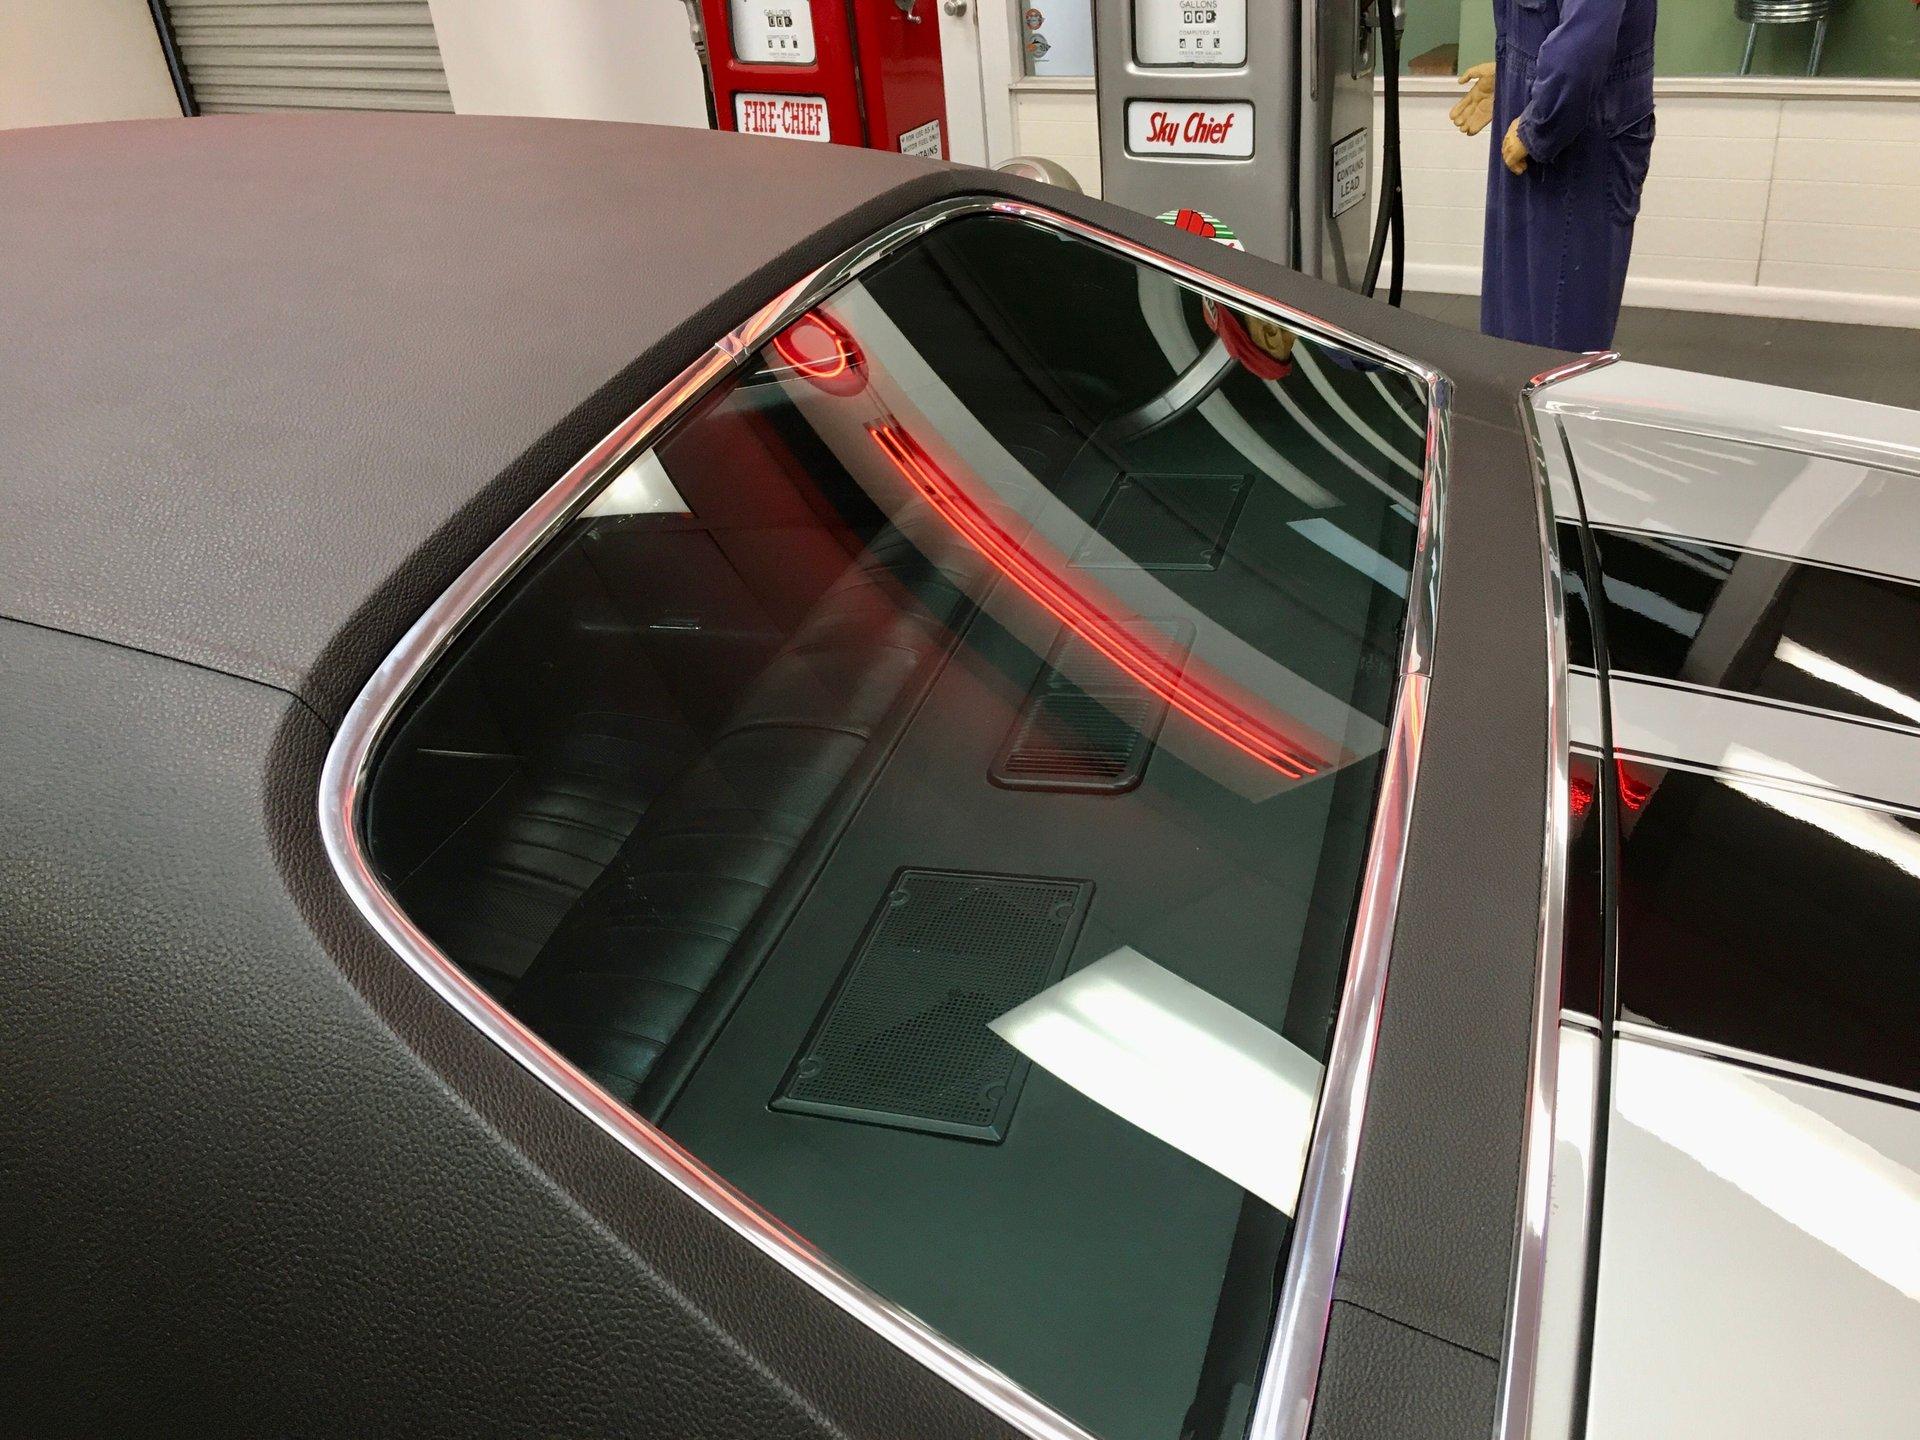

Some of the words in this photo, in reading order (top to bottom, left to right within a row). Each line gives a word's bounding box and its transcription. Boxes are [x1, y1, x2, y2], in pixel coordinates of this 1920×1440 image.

[1180, 1, 1217, 9] GALLONS
[1147, 112, 1179, 146] Sky
[1184, 112, 1234, 143] Chief
[1341, 176, 1360, 198] LEAD
